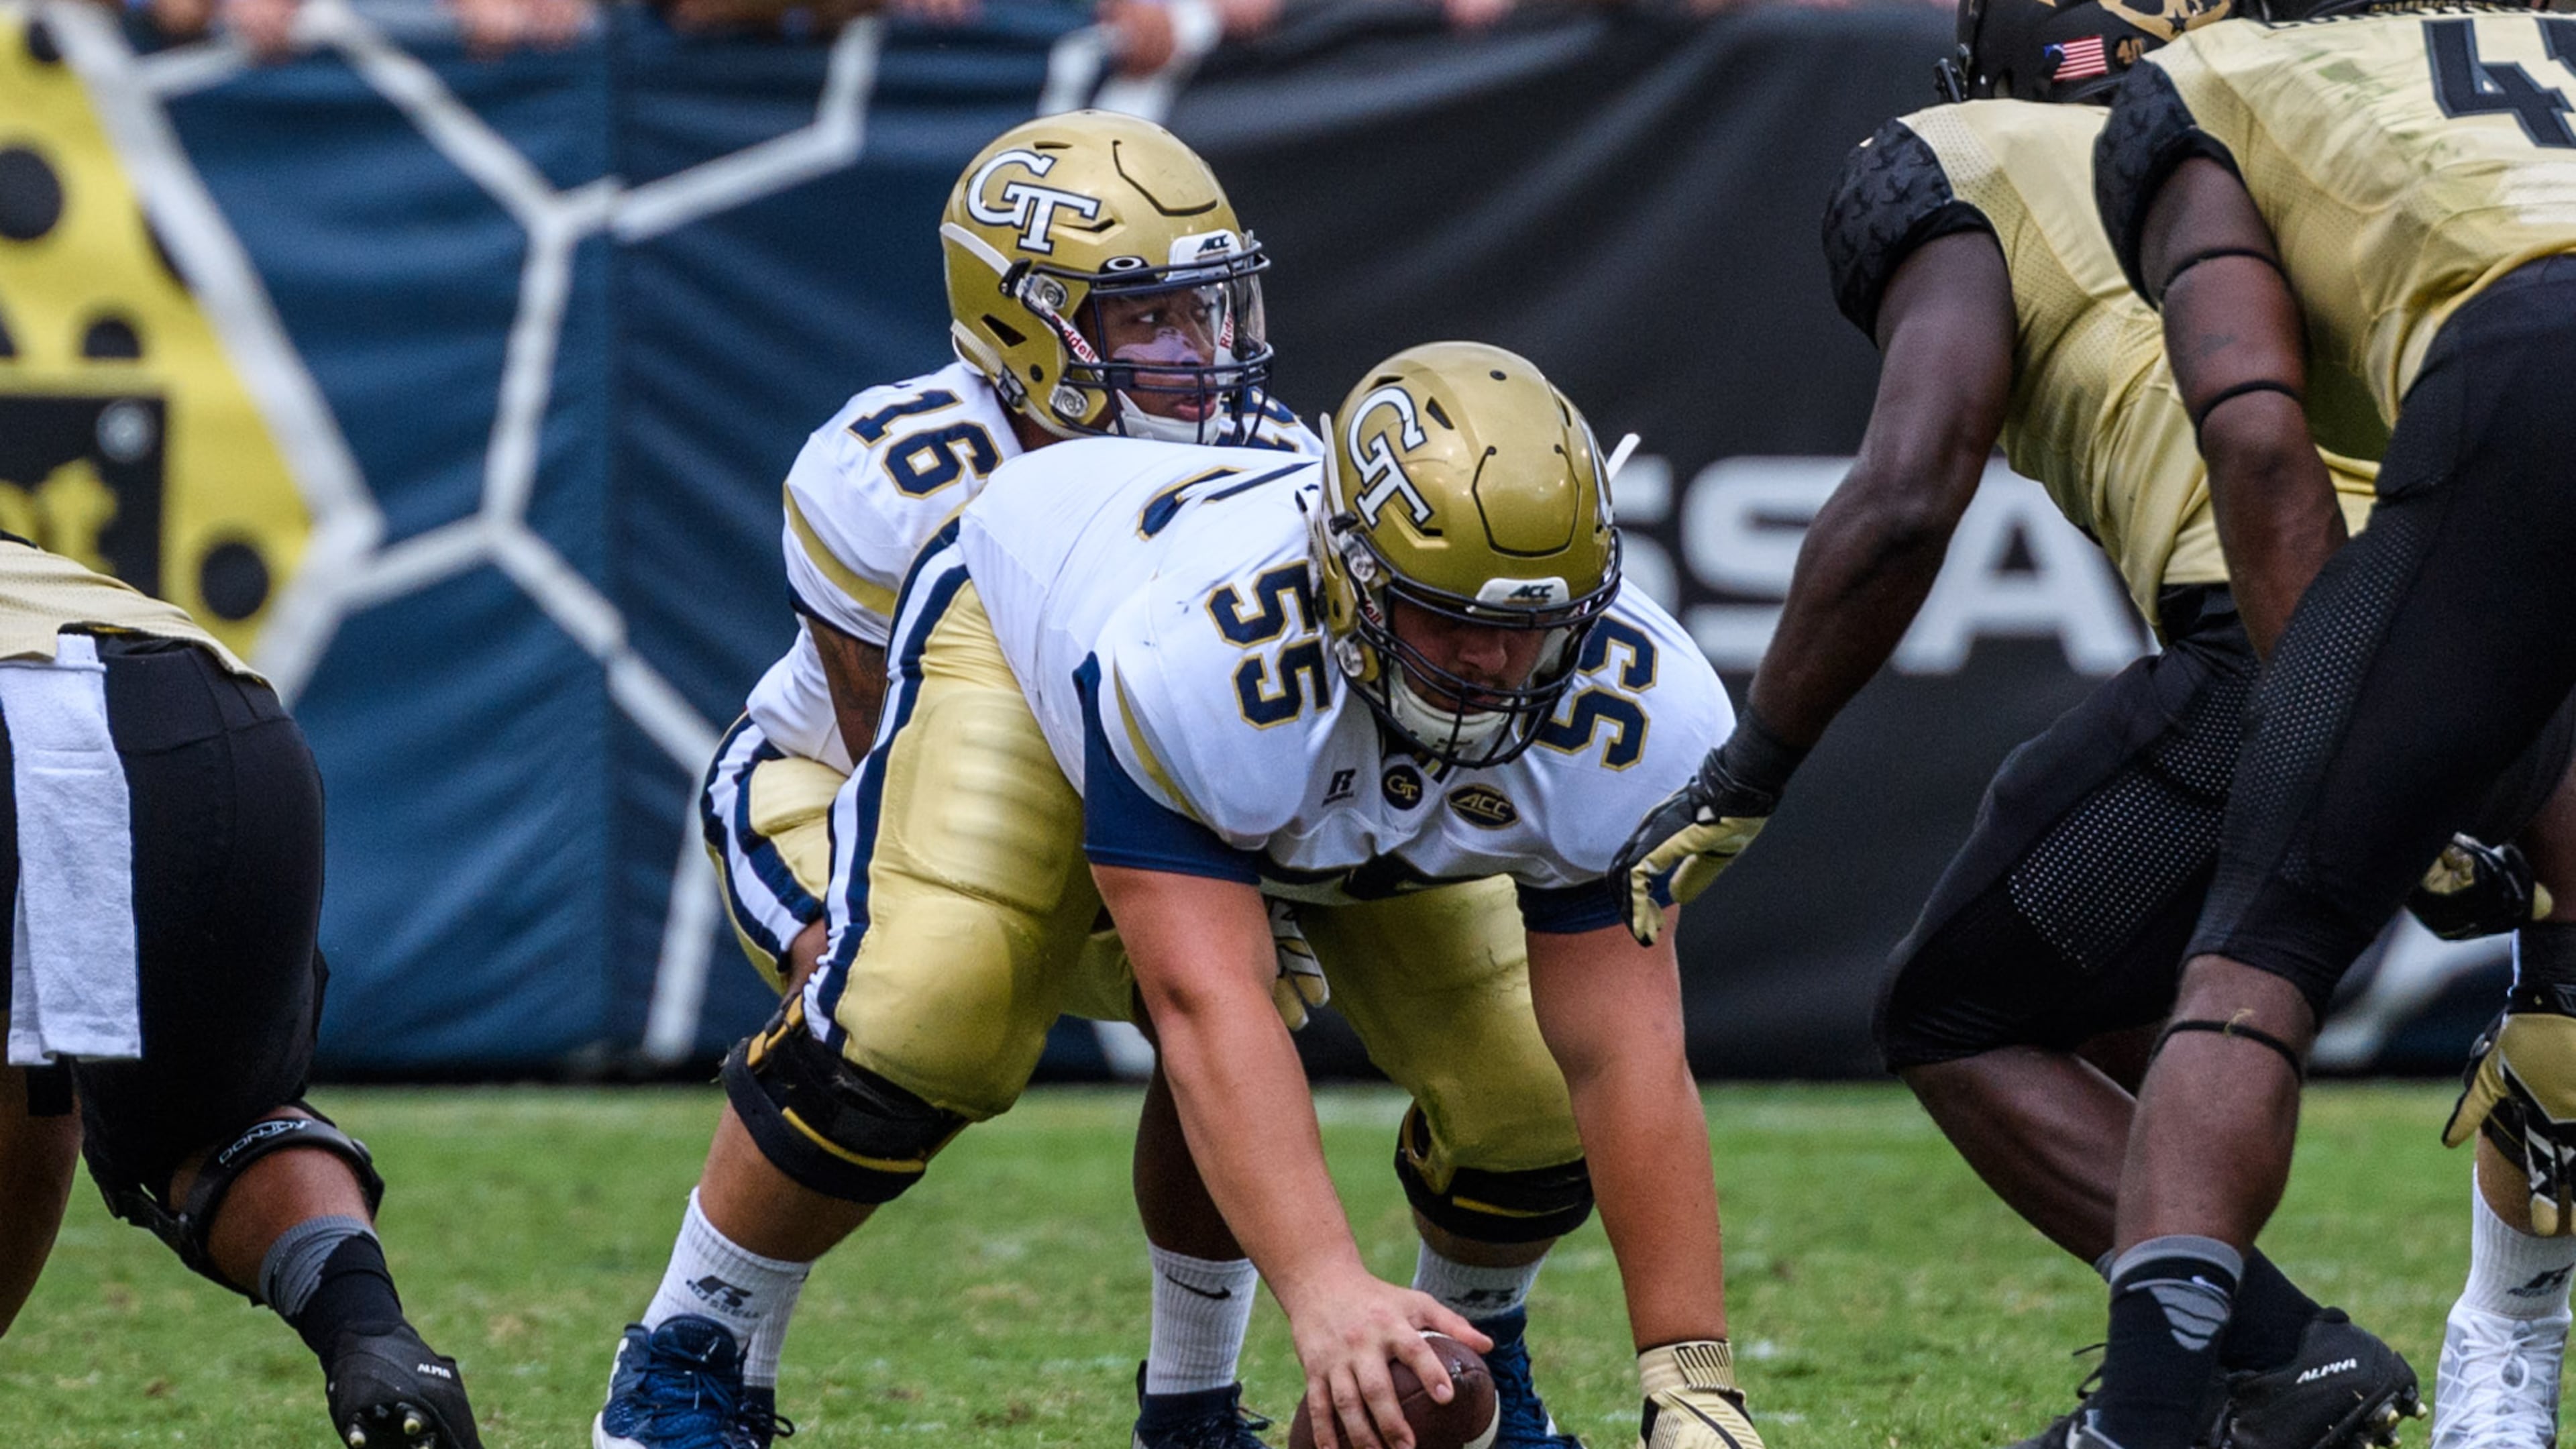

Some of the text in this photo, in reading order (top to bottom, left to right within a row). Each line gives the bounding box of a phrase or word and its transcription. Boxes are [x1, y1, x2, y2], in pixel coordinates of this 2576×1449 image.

[2422, 17, 2576, 149] 4
[966, 148, 1102, 255] GT
[1197, 234, 1230, 253] ACC
[1051, 313, 1096, 364] ddell
[843, 389, 1004, 500] 16
[1347, 386, 1436, 529] GT
[1509, 584, 1554, 598] ACC
[1205, 559, 1334, 731] 55
[1387, 774, 1418, 800] GT
[1455, 792, 1510, 818] ACC
[2296, 1358, 2357, 1384] ALPHA
